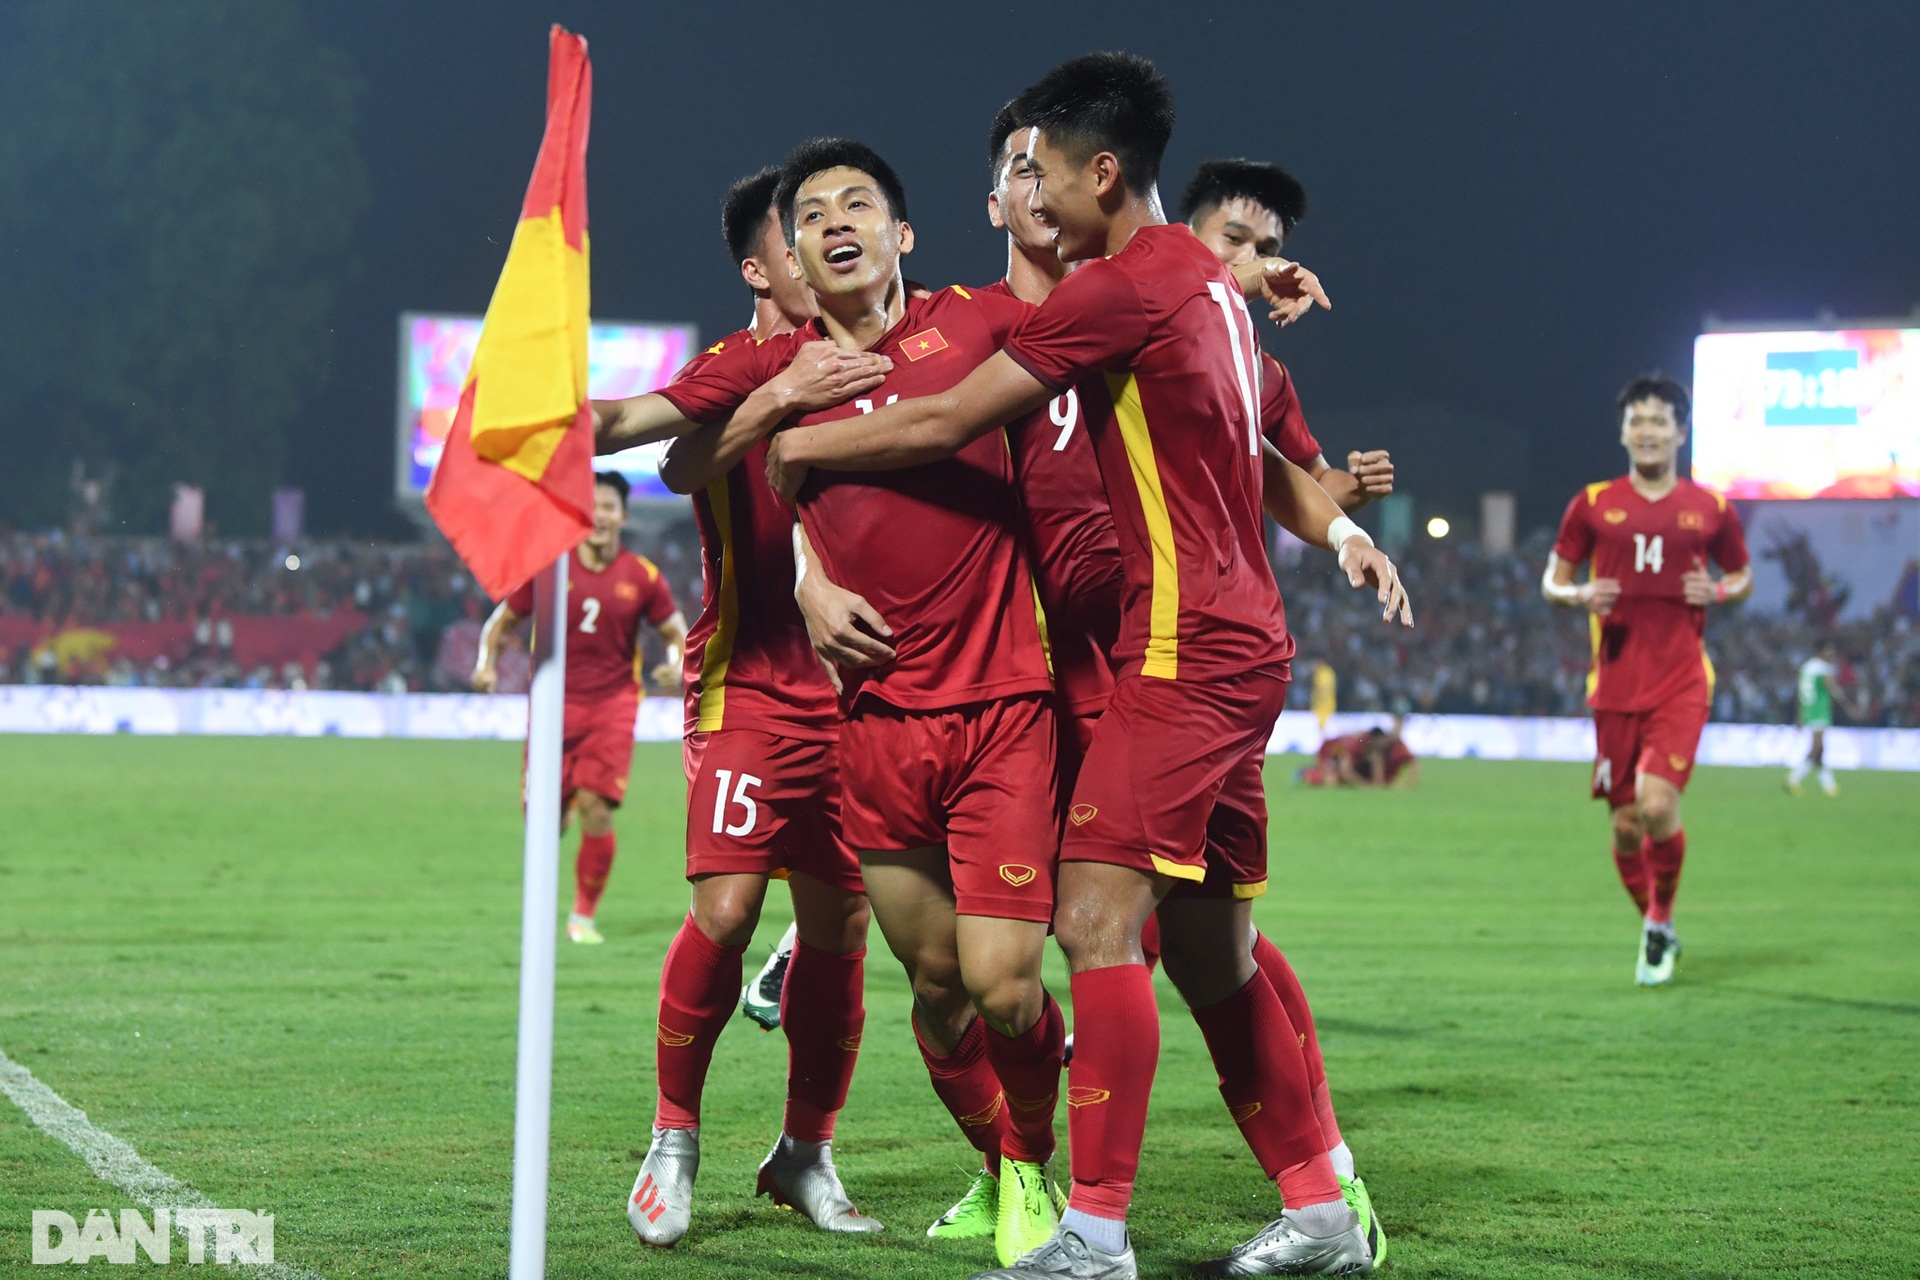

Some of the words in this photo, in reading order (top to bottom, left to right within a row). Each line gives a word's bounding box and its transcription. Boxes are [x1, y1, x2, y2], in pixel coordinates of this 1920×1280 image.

[1049, 388, 1078, 451] 9
[1633, 533, 1664, 574] 14
[579, 597, 601, 634] 2
[712, 769, 762, 837] 15
